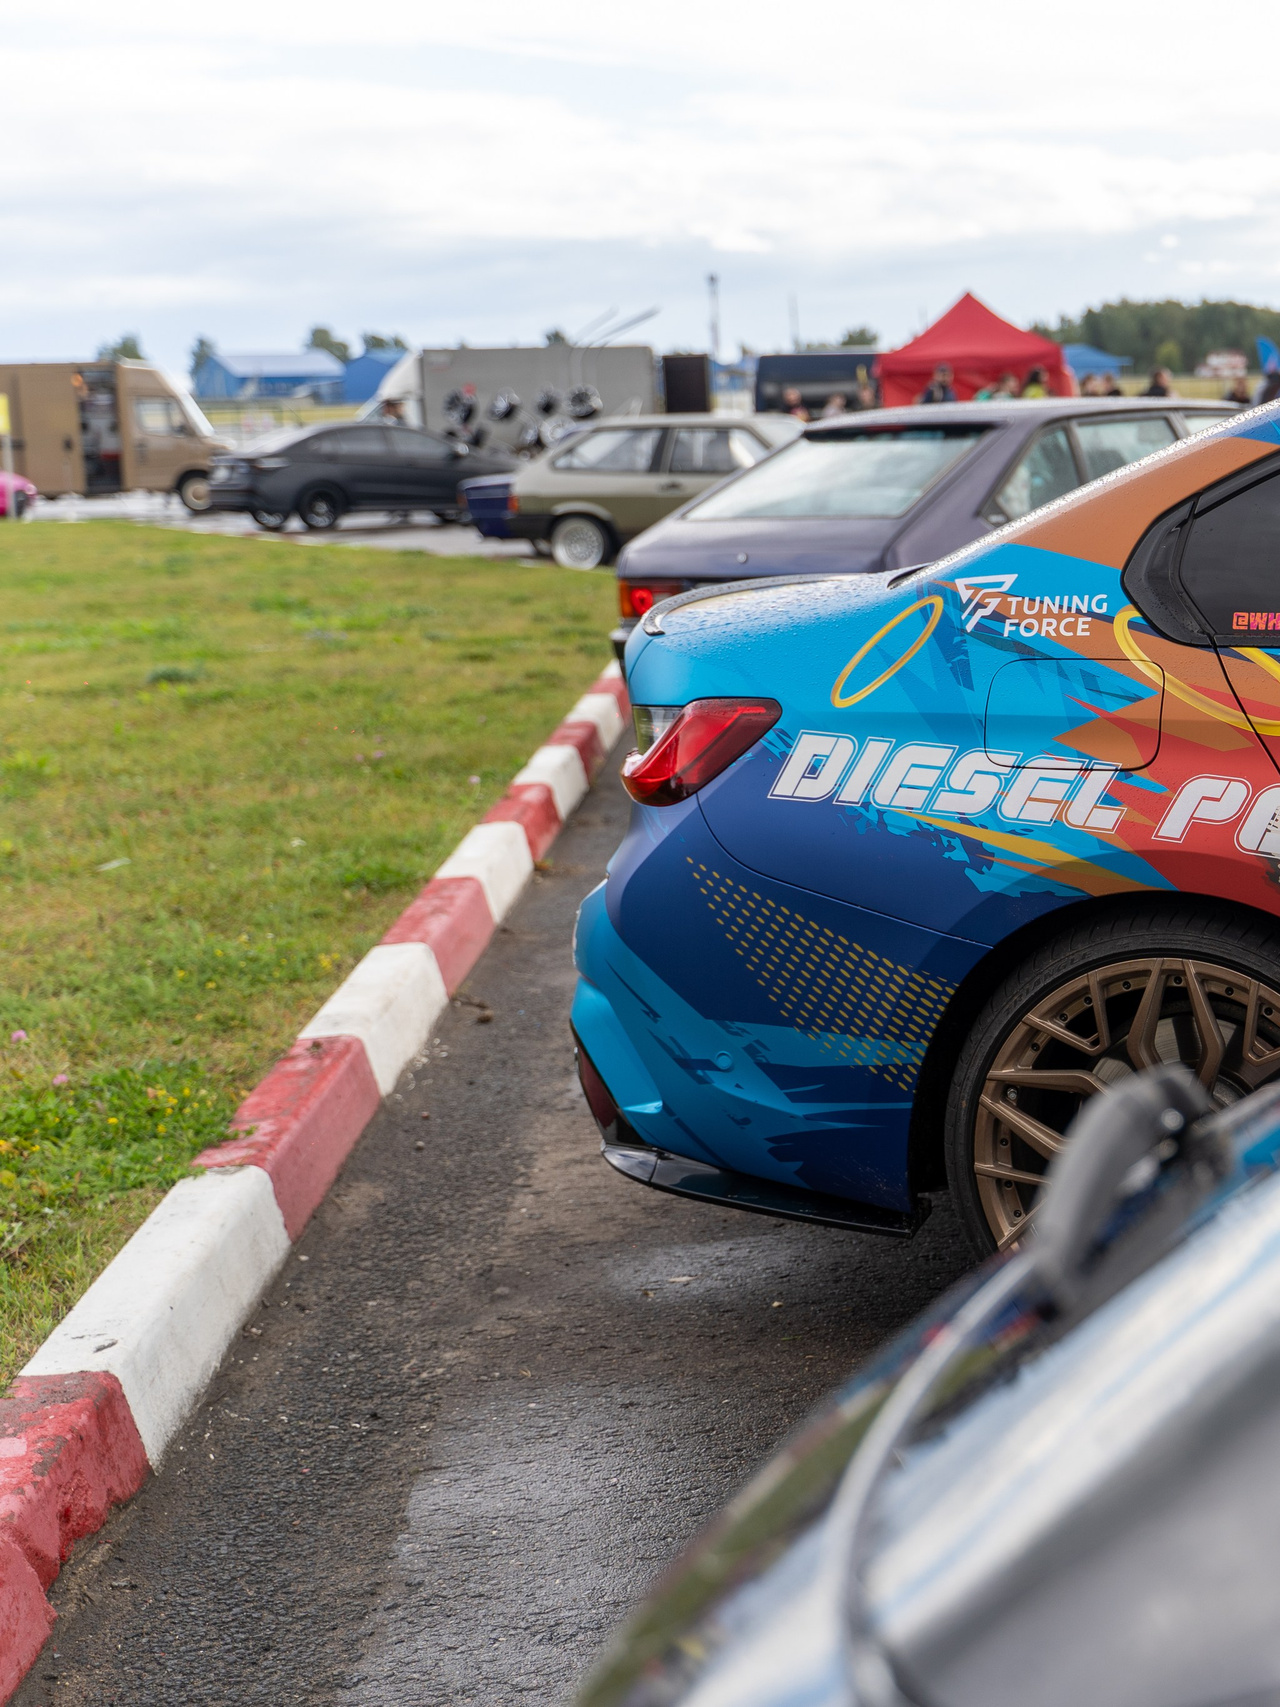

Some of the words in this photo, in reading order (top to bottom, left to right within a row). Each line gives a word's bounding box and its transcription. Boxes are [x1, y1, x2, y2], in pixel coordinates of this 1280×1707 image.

[1007, 594, 1108, 614] TUNING
[1003, 616, 1092, 637] FORCE
[767, 729, 1127, 834] DIESEL
